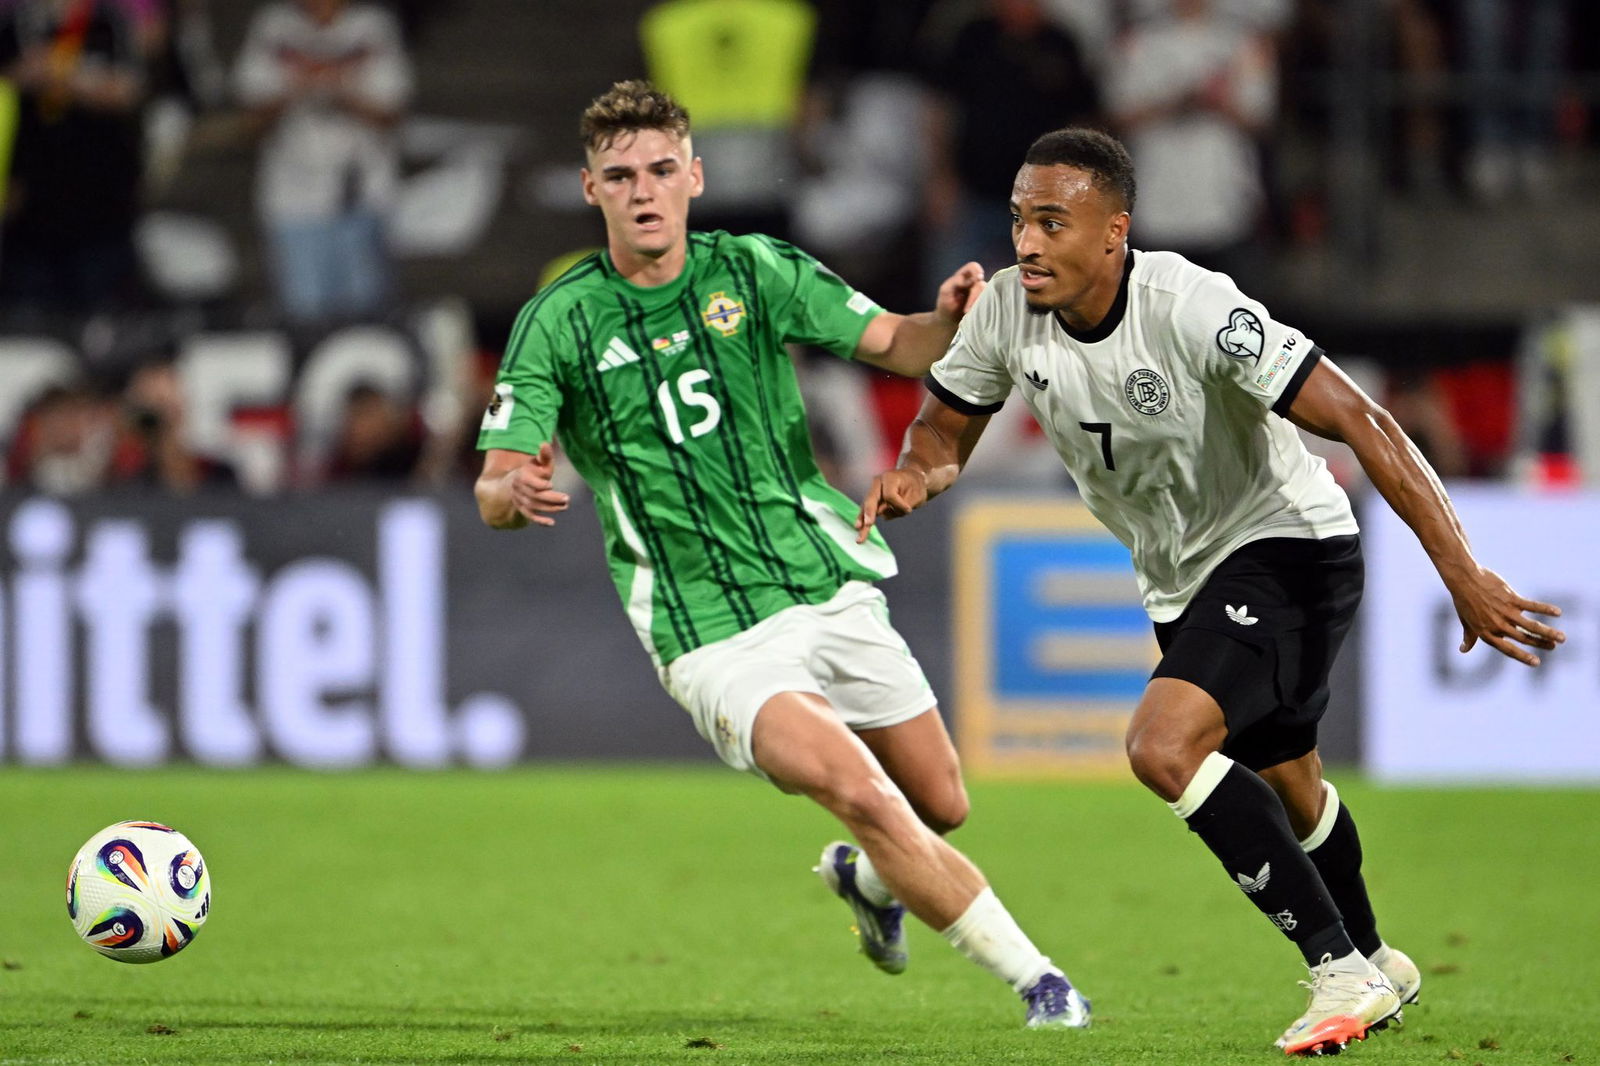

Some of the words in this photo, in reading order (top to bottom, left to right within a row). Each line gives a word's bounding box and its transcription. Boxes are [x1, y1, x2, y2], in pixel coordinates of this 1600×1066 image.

[657, 368, 721, 445] 15
[1078, 421, 1116, 472] 7
[0, 499, 525, 767] ittel.
